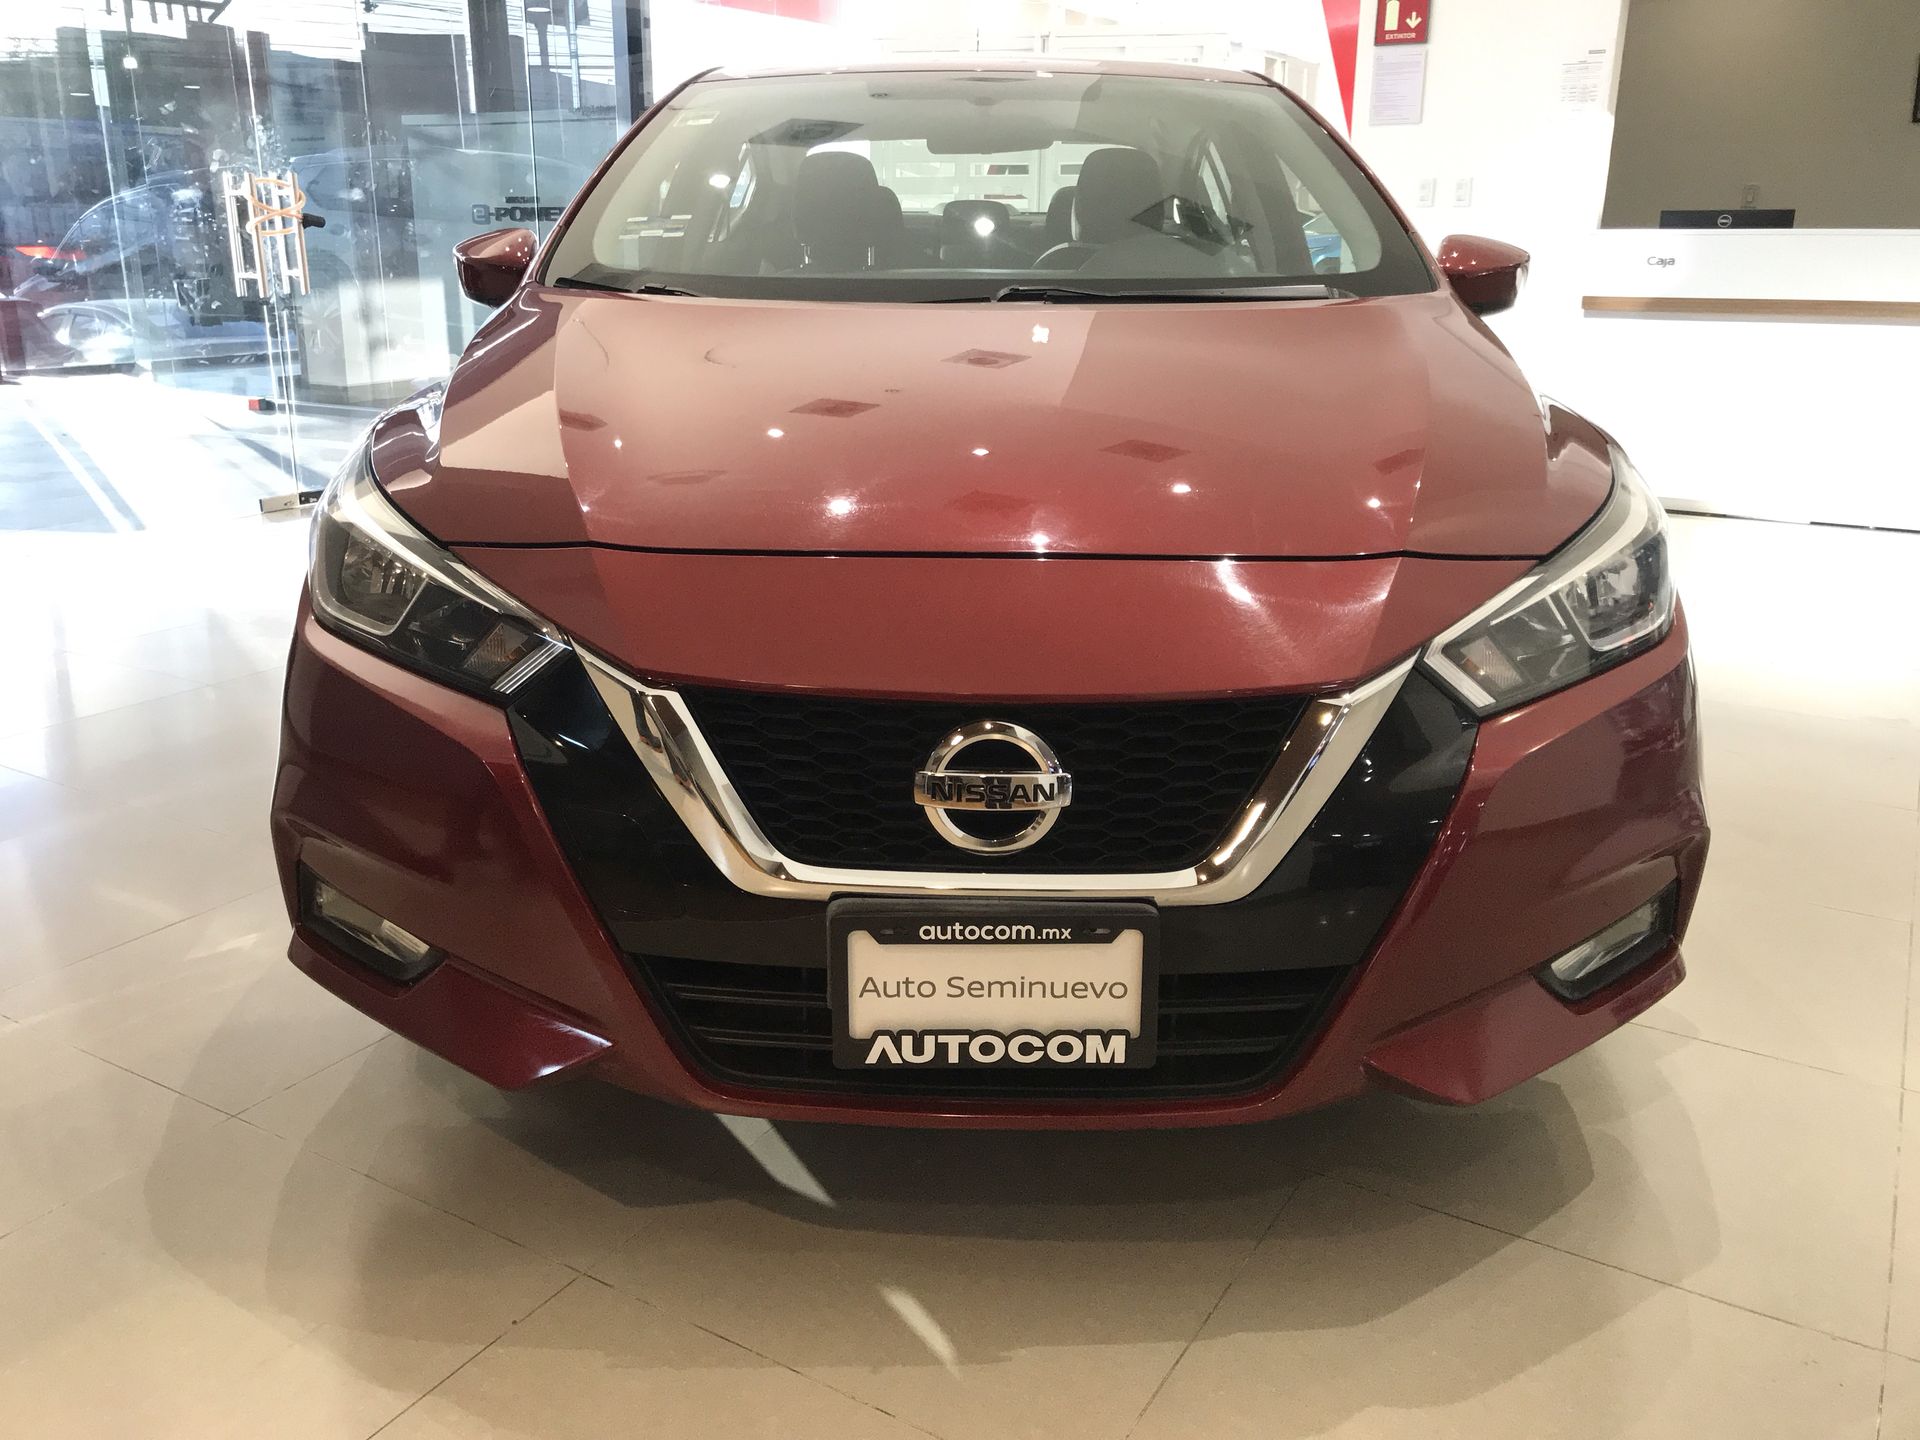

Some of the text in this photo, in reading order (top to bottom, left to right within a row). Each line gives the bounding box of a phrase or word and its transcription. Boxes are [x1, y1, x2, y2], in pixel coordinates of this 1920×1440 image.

[471, 204, 567, 225] e-POWE
[1647, 256, 1676, 268] Caja
[931, 783, 1055, 803] NISSAN
[919, 922, 1072, 941] autocom.mx
[858, 975, 1129, 1000] Auto Seminuevo
[864, 1034, 1127, 1065] AUTOCOM
